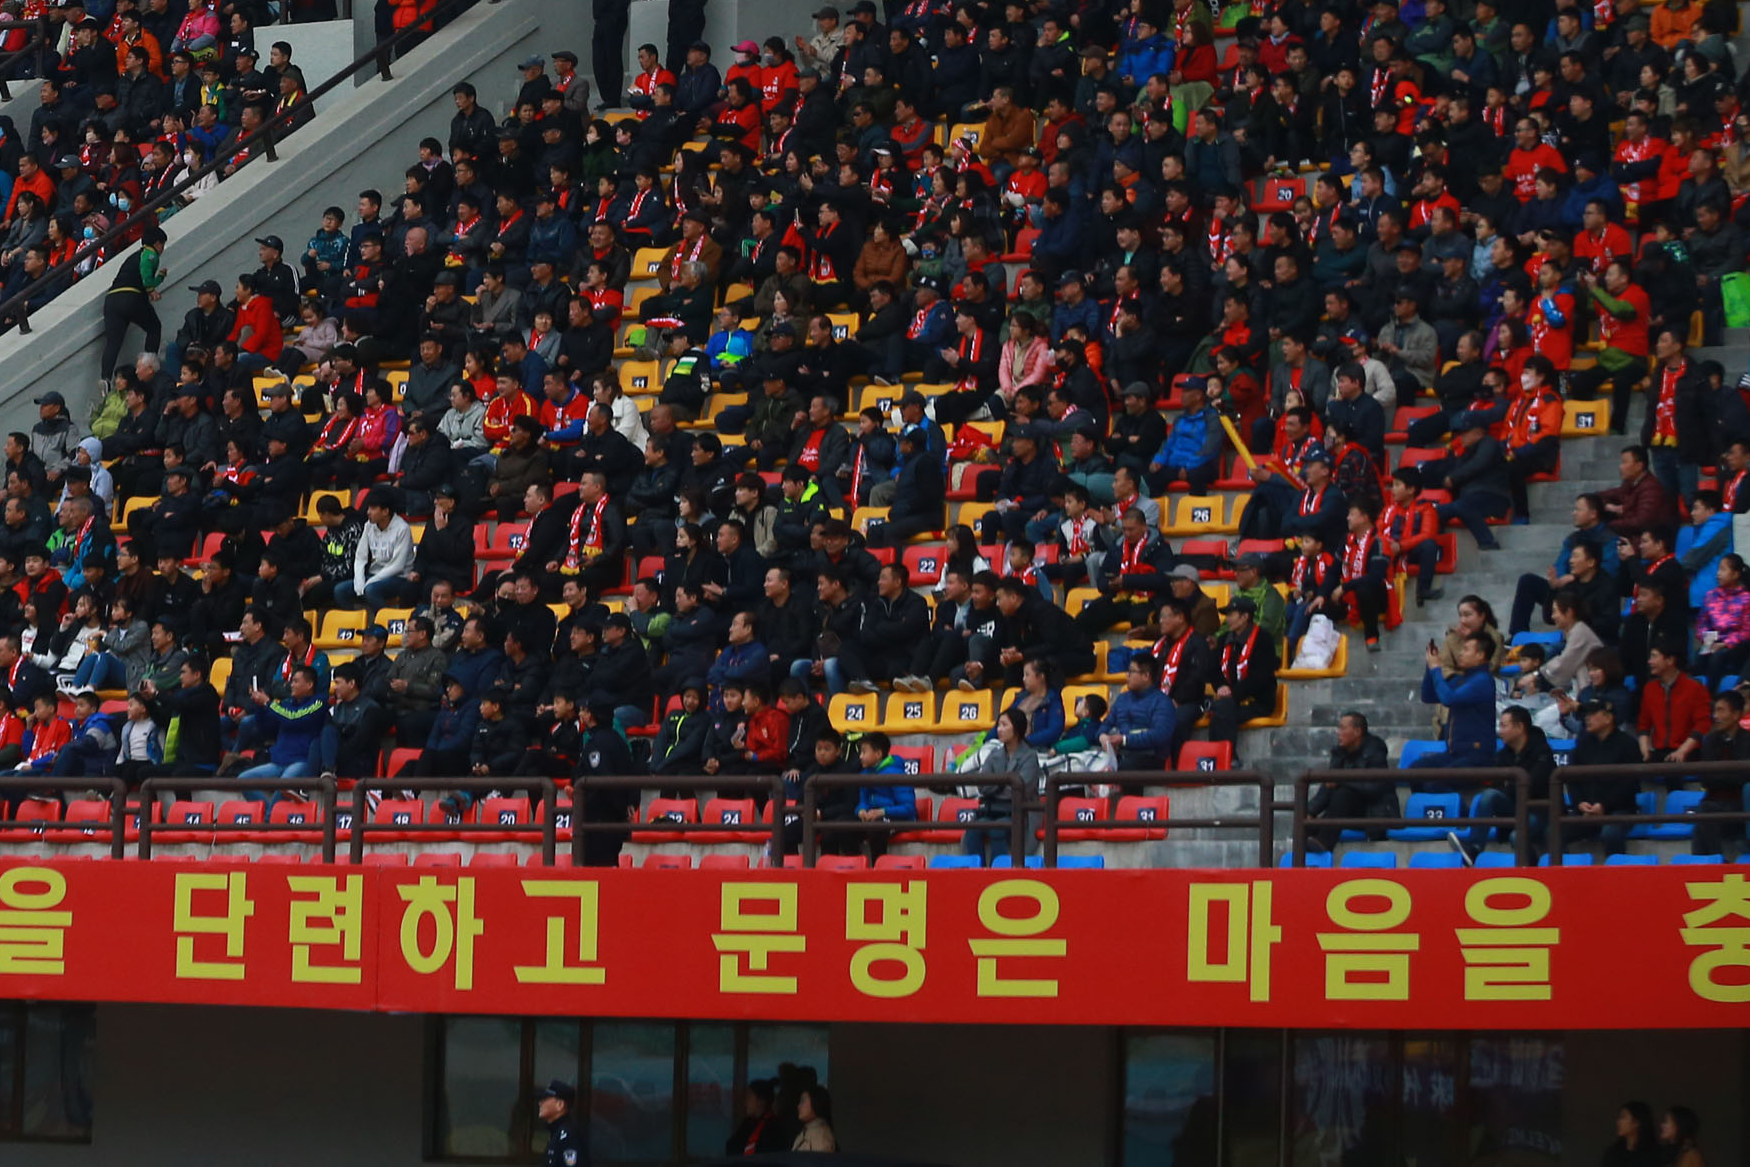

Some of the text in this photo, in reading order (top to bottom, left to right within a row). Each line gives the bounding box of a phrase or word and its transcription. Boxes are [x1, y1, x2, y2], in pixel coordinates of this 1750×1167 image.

[834, 327, 847, 339] 14
[1193, 509, 1210, 523] 26
[919, 559, 936, 574] 22
[389, 621, 404, 634] 13
[847, 706, 864, 720] 24
[905, 704, 922, 718] 25
[960, 706, 978, 720] 26
[903, 761, 919, 775] 26
[338, 815, 353, 830] 17
[555, 813, 570, 829] 21
[173, 872, 607, 991] 단련하고
[712, 880, 1068, 998] 문명은
[1187, 879, 1561, 1002] 마음을
